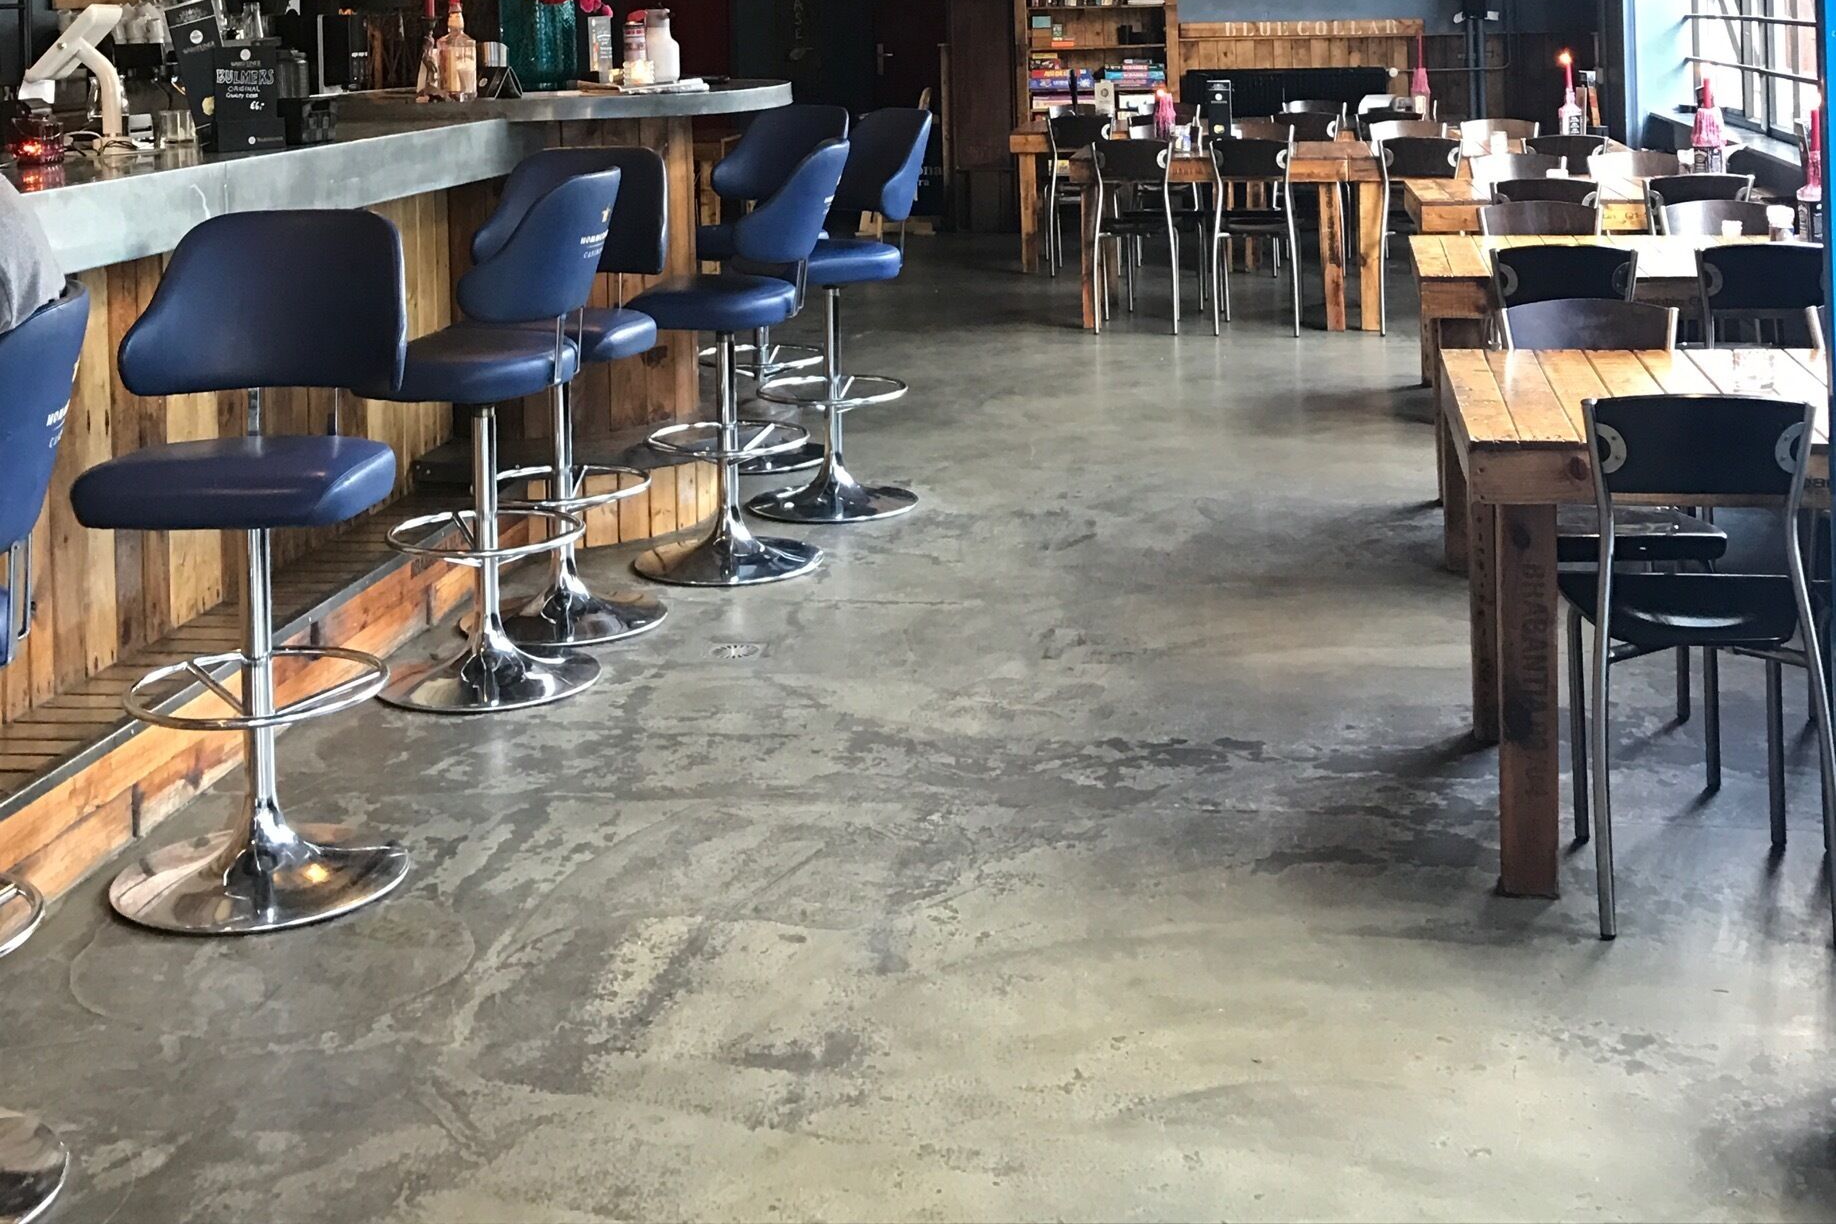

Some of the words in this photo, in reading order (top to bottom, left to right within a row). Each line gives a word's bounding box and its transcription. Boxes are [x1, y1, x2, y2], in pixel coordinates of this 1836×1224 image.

[1225, 21, 1289, 37] BLUE
[1297, 19, 1399, 36] COLLAR
[216, 68, 275, 85] BULMERS
